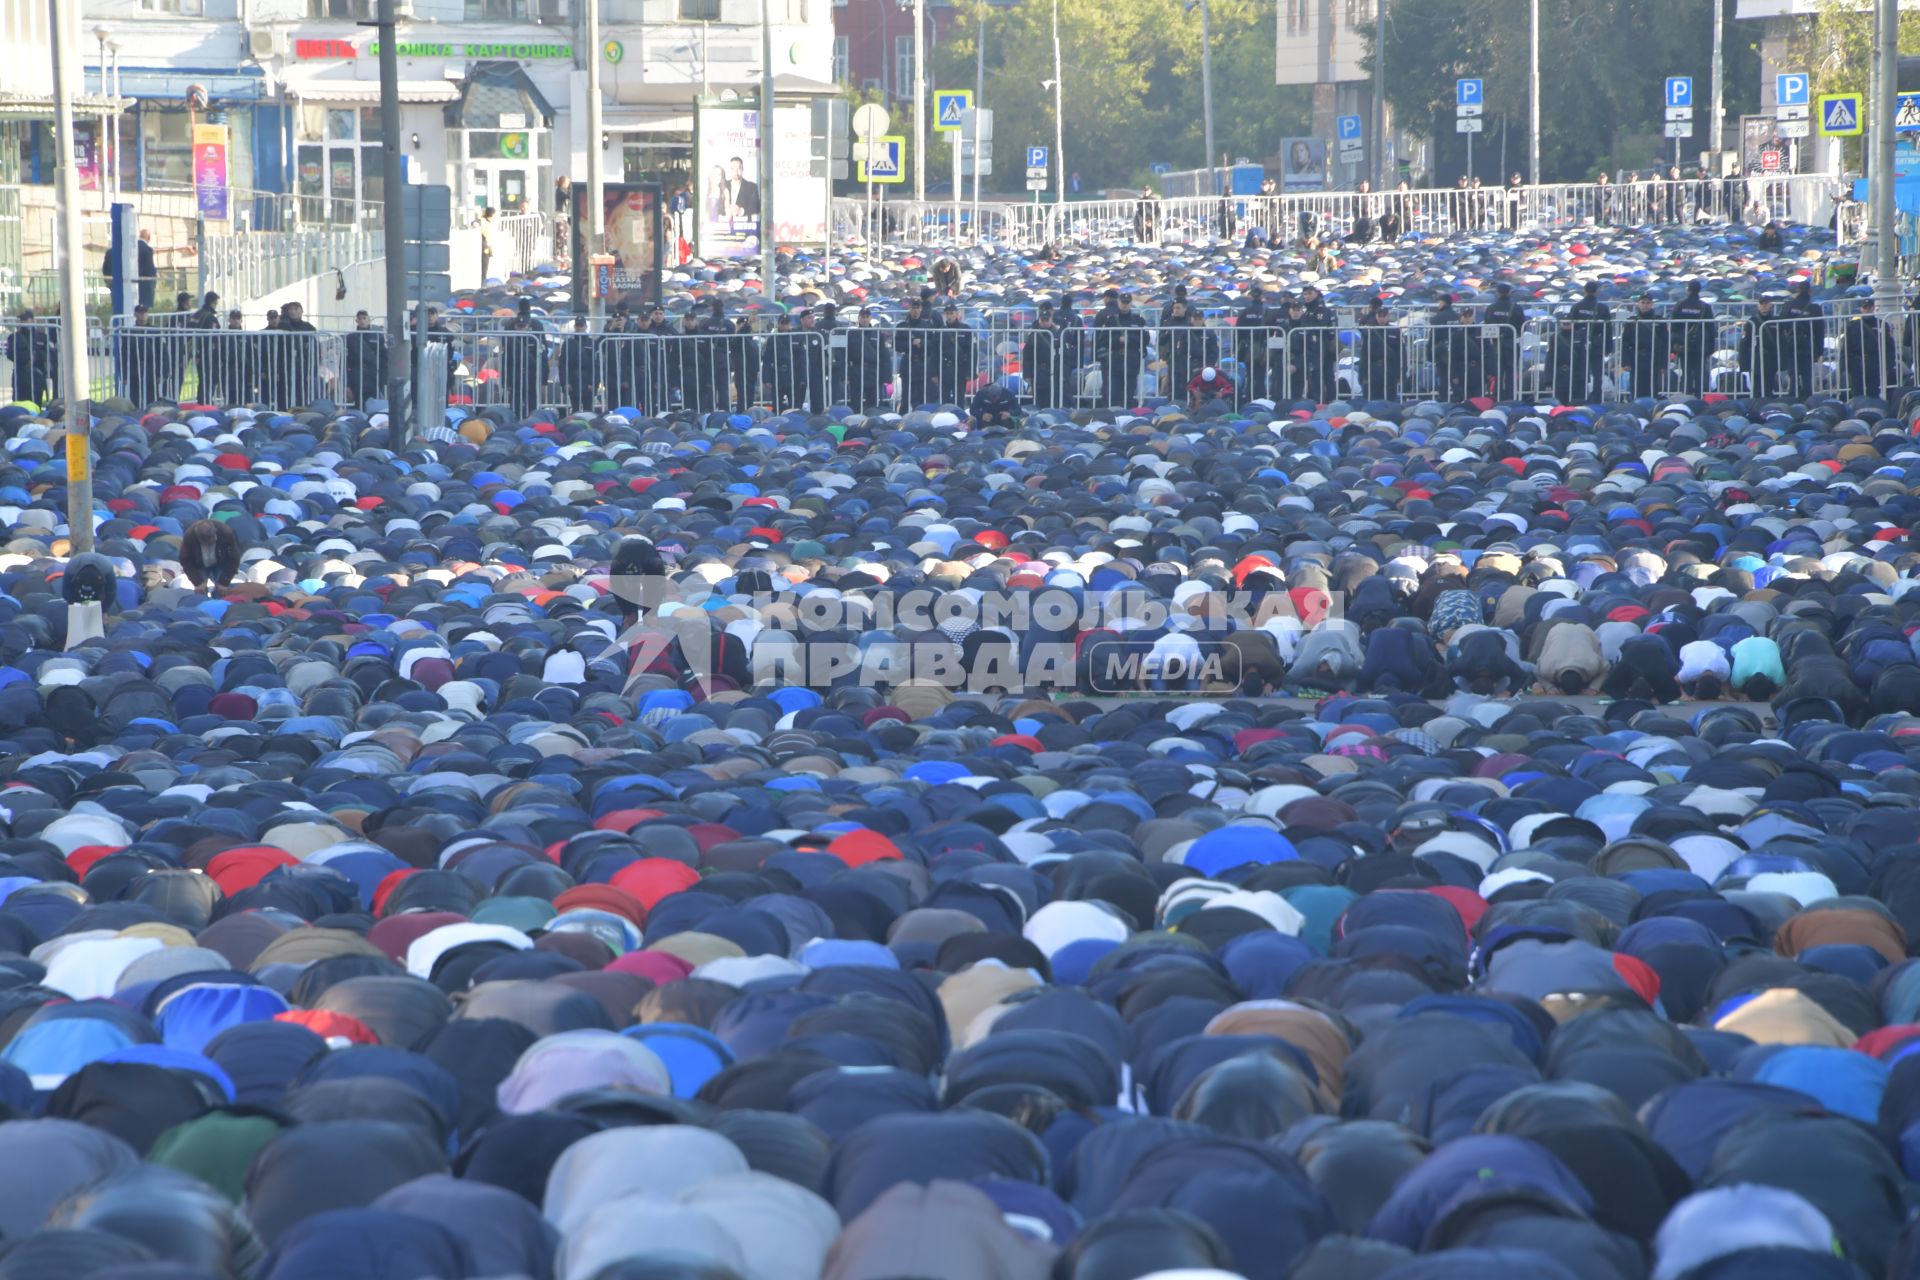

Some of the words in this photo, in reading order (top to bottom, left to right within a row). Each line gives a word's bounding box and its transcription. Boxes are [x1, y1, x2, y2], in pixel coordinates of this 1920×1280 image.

[369, 42, 453, 57] КОШКА
[464, 43, 573, 58] КАРТОШКА
[1463, 82, 1477, 101] P
[1673, 81, 1688, 103] P
[1786, 76, 1803, 102] P
[1343, 118, 1356, 137] P
[1033, 149, 1044, 165] P
[599, 265, 609, 295] SOS
